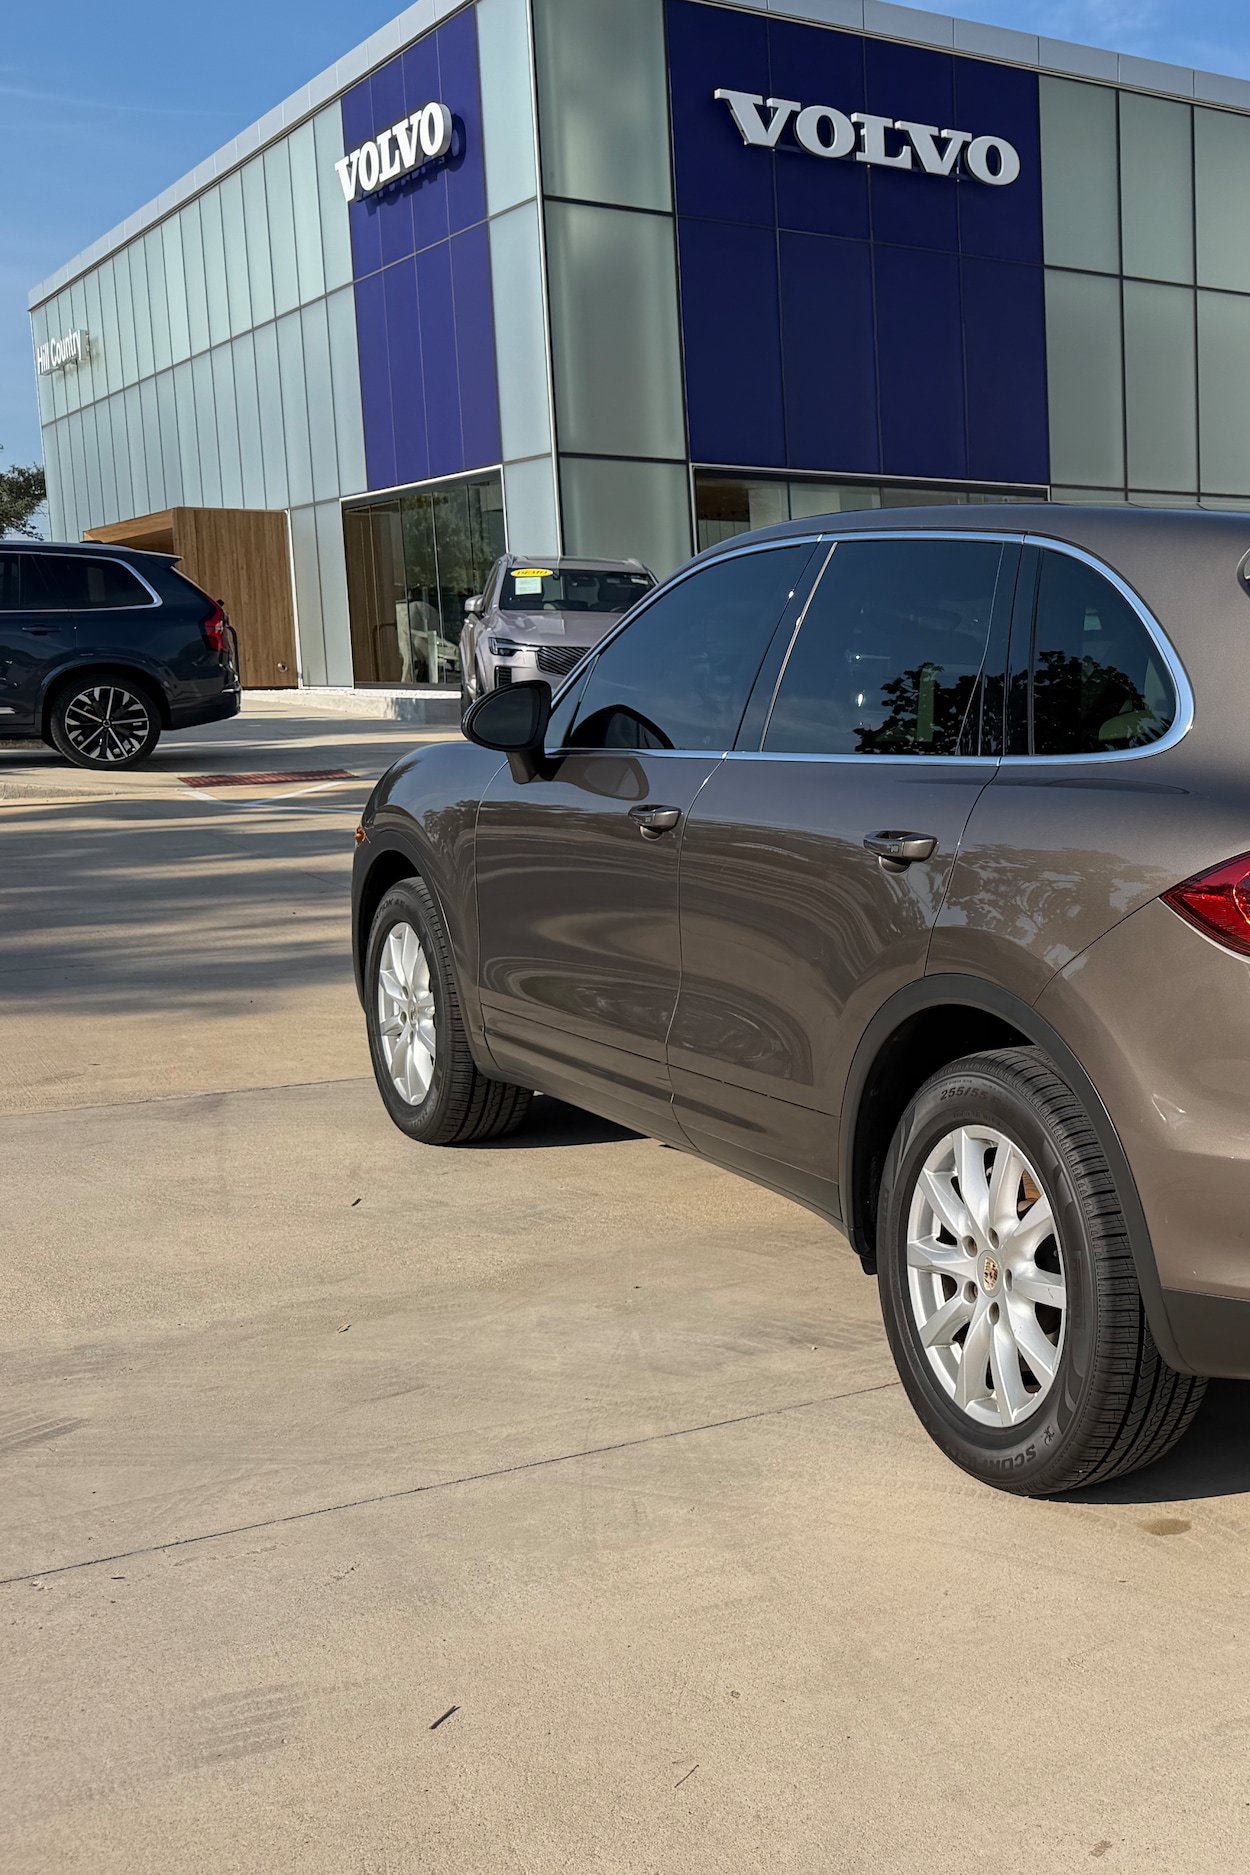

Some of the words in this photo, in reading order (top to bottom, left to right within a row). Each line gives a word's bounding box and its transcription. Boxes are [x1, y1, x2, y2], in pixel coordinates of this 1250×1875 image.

[335, 102, 446, 202] VOLVO
[714, 88, 1020, 186] VOLVO
[37, 342, 50, 375] Hill
[50, 328, 81, 367] Country
[940, 1086, 989, 1100] 255/55
